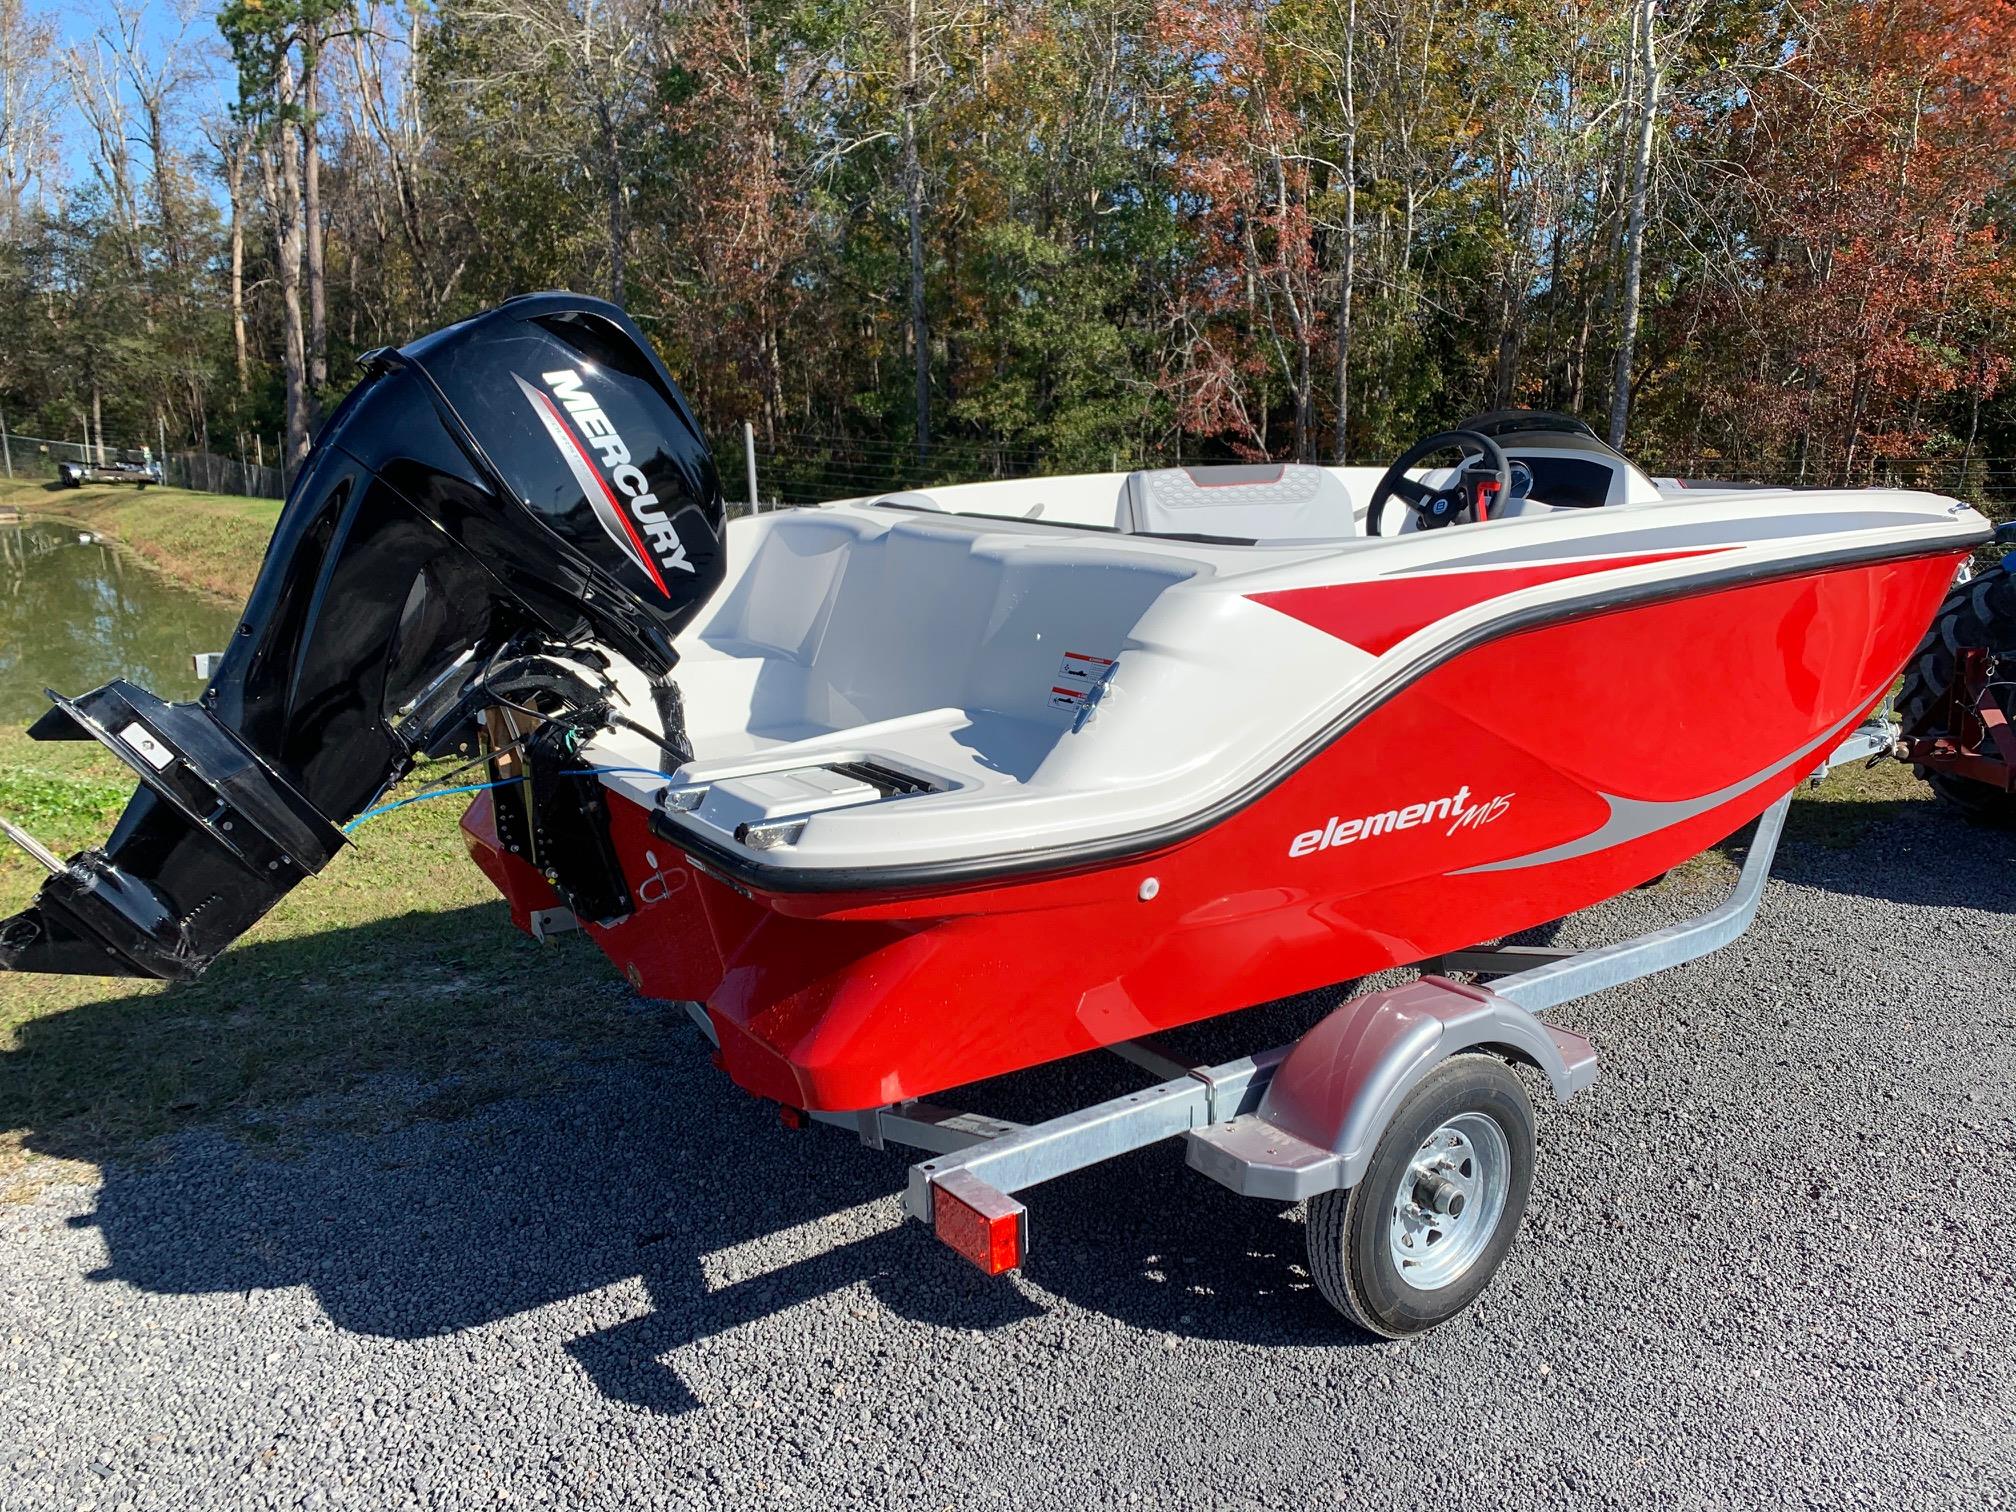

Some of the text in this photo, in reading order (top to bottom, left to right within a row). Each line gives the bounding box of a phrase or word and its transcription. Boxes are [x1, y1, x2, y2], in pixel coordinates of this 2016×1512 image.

[542, 369, 695, 574] MERCURY
[1288, 785, 1516, 858] element M15
